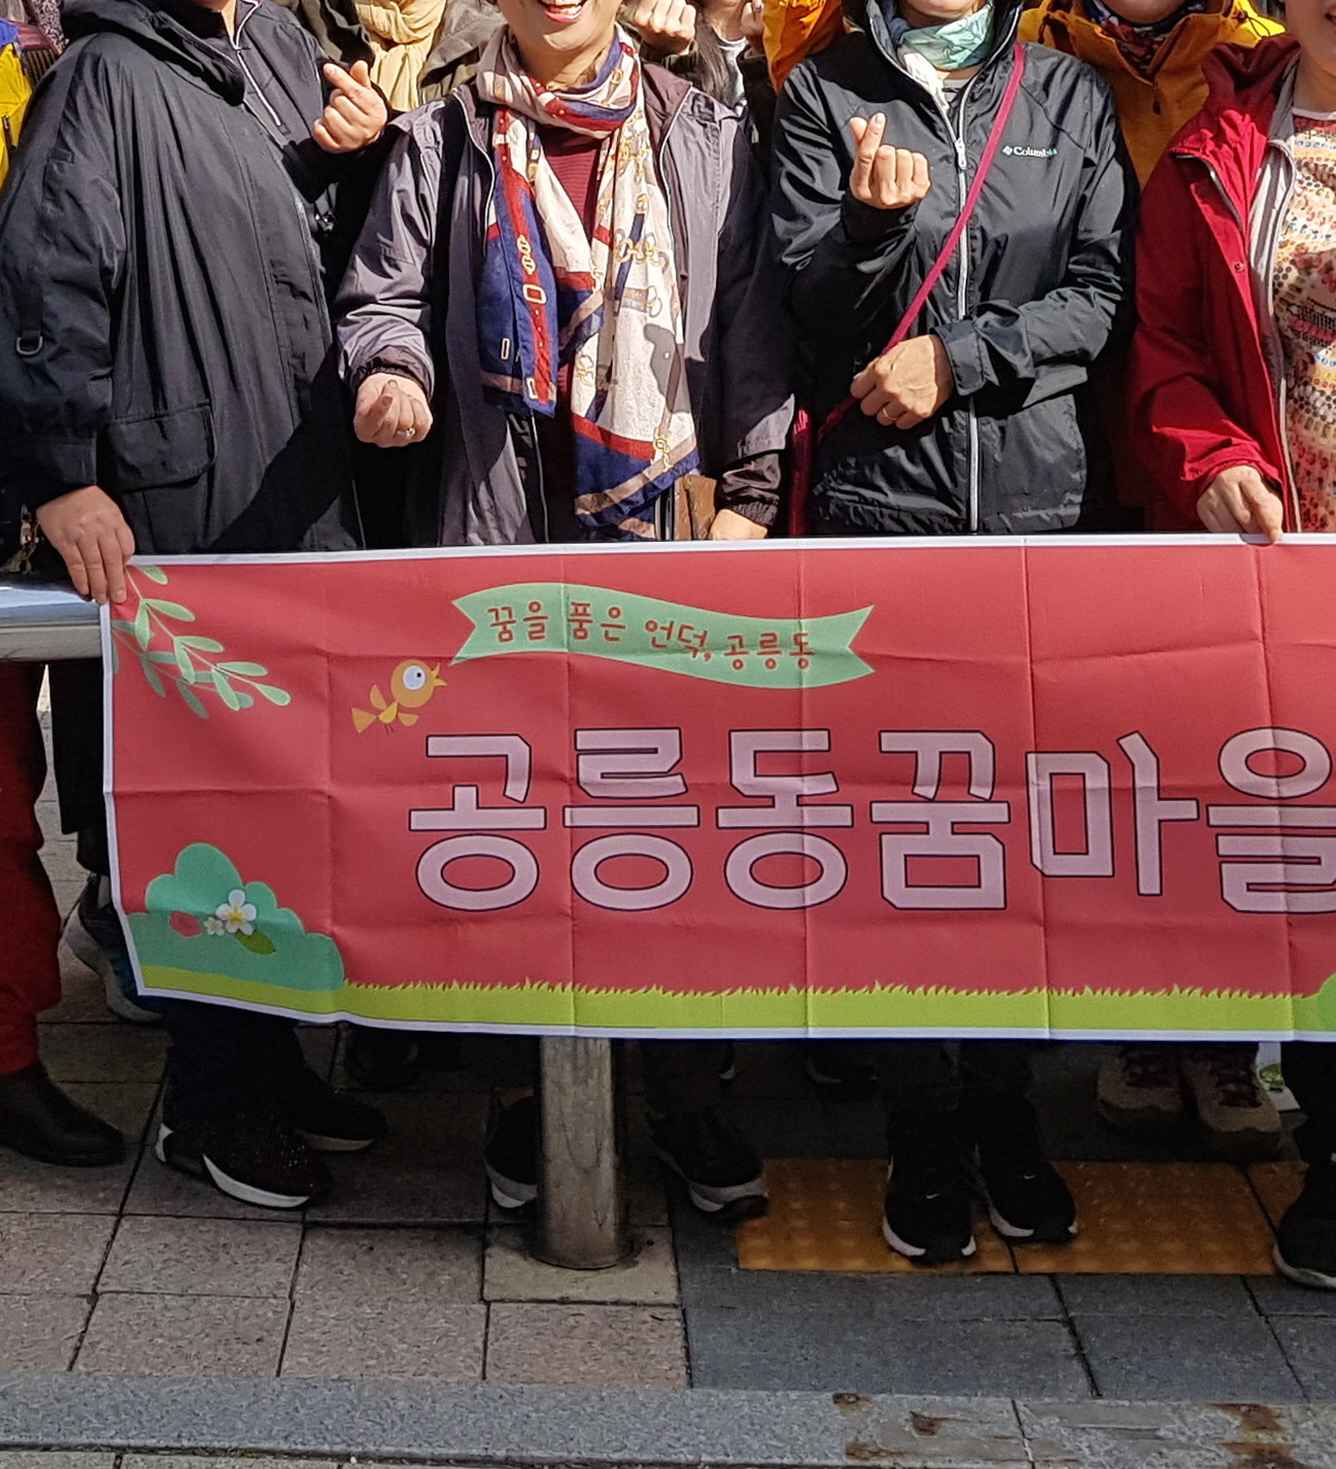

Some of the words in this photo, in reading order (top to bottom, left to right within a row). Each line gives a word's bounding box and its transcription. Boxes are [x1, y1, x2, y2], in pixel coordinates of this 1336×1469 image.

[486, 601, 549, 644] 꿈을
[567, 601, 627, 643] 품은
[643, 618, 713, 662] 언덕,
[722, 631, 816, 672] 공릉동
